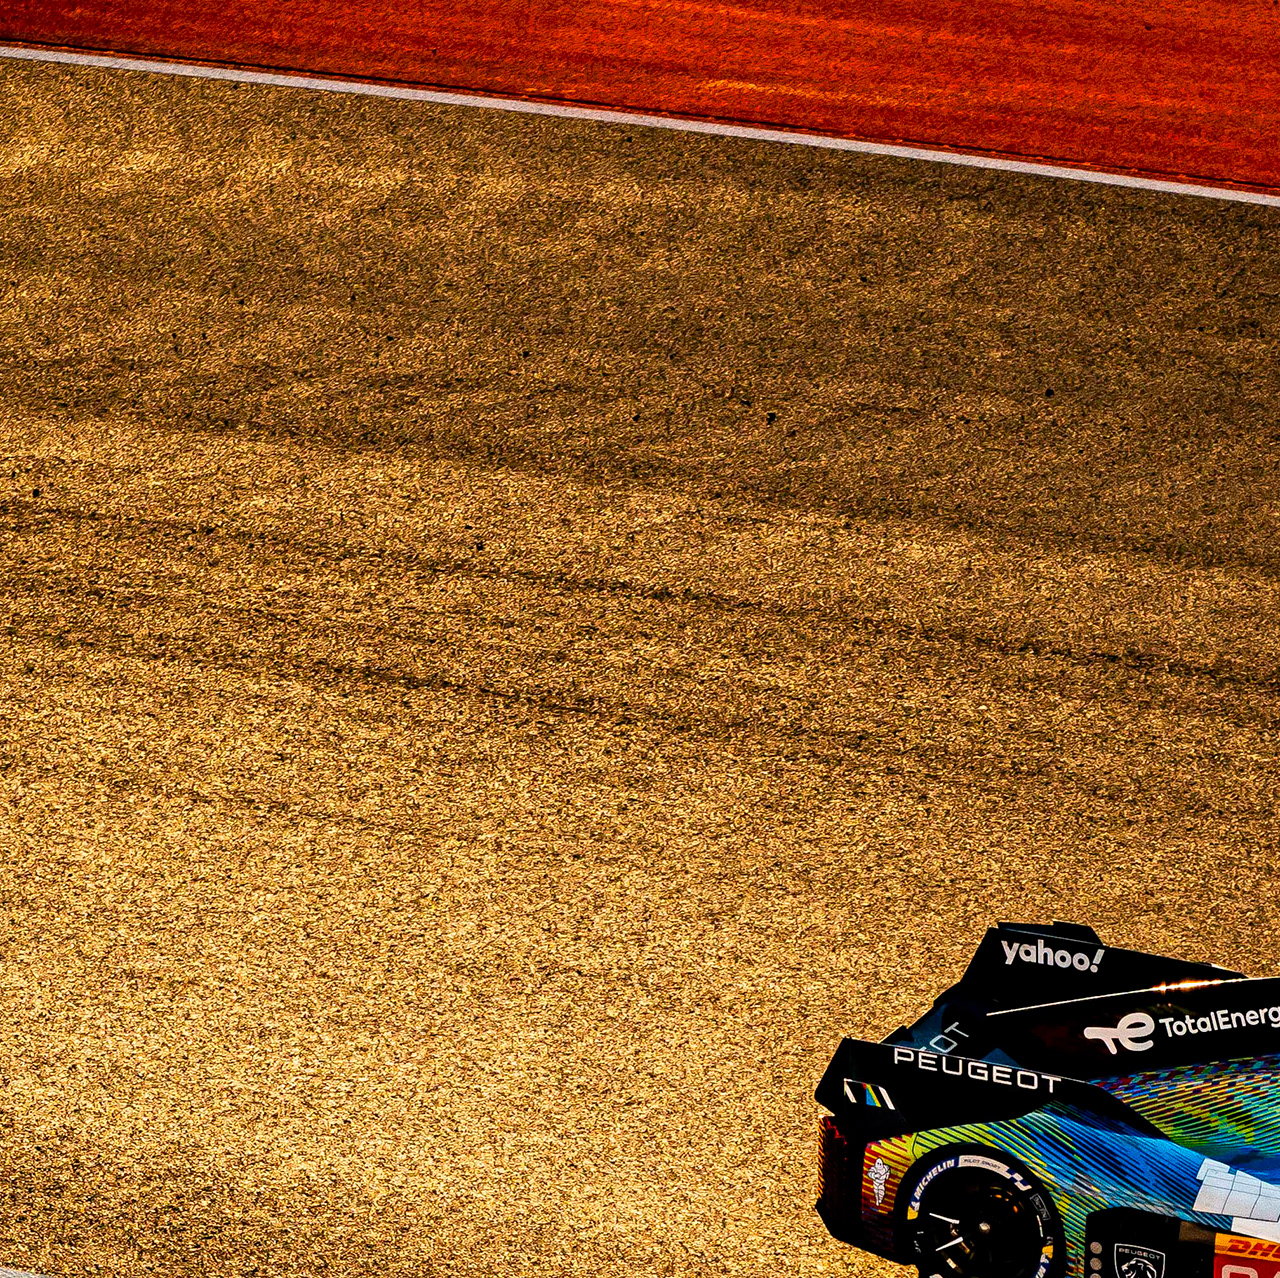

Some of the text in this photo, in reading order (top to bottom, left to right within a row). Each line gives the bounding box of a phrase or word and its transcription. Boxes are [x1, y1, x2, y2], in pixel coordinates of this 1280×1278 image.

[1001, 939, 1105, 973] yahoo!
[894, 1048, 1061, 1093] PEUGEOT
[914, 1159, 955, 1200] MICHELIN
[1118, 1247, 1161, 1260] PEUGEOT
